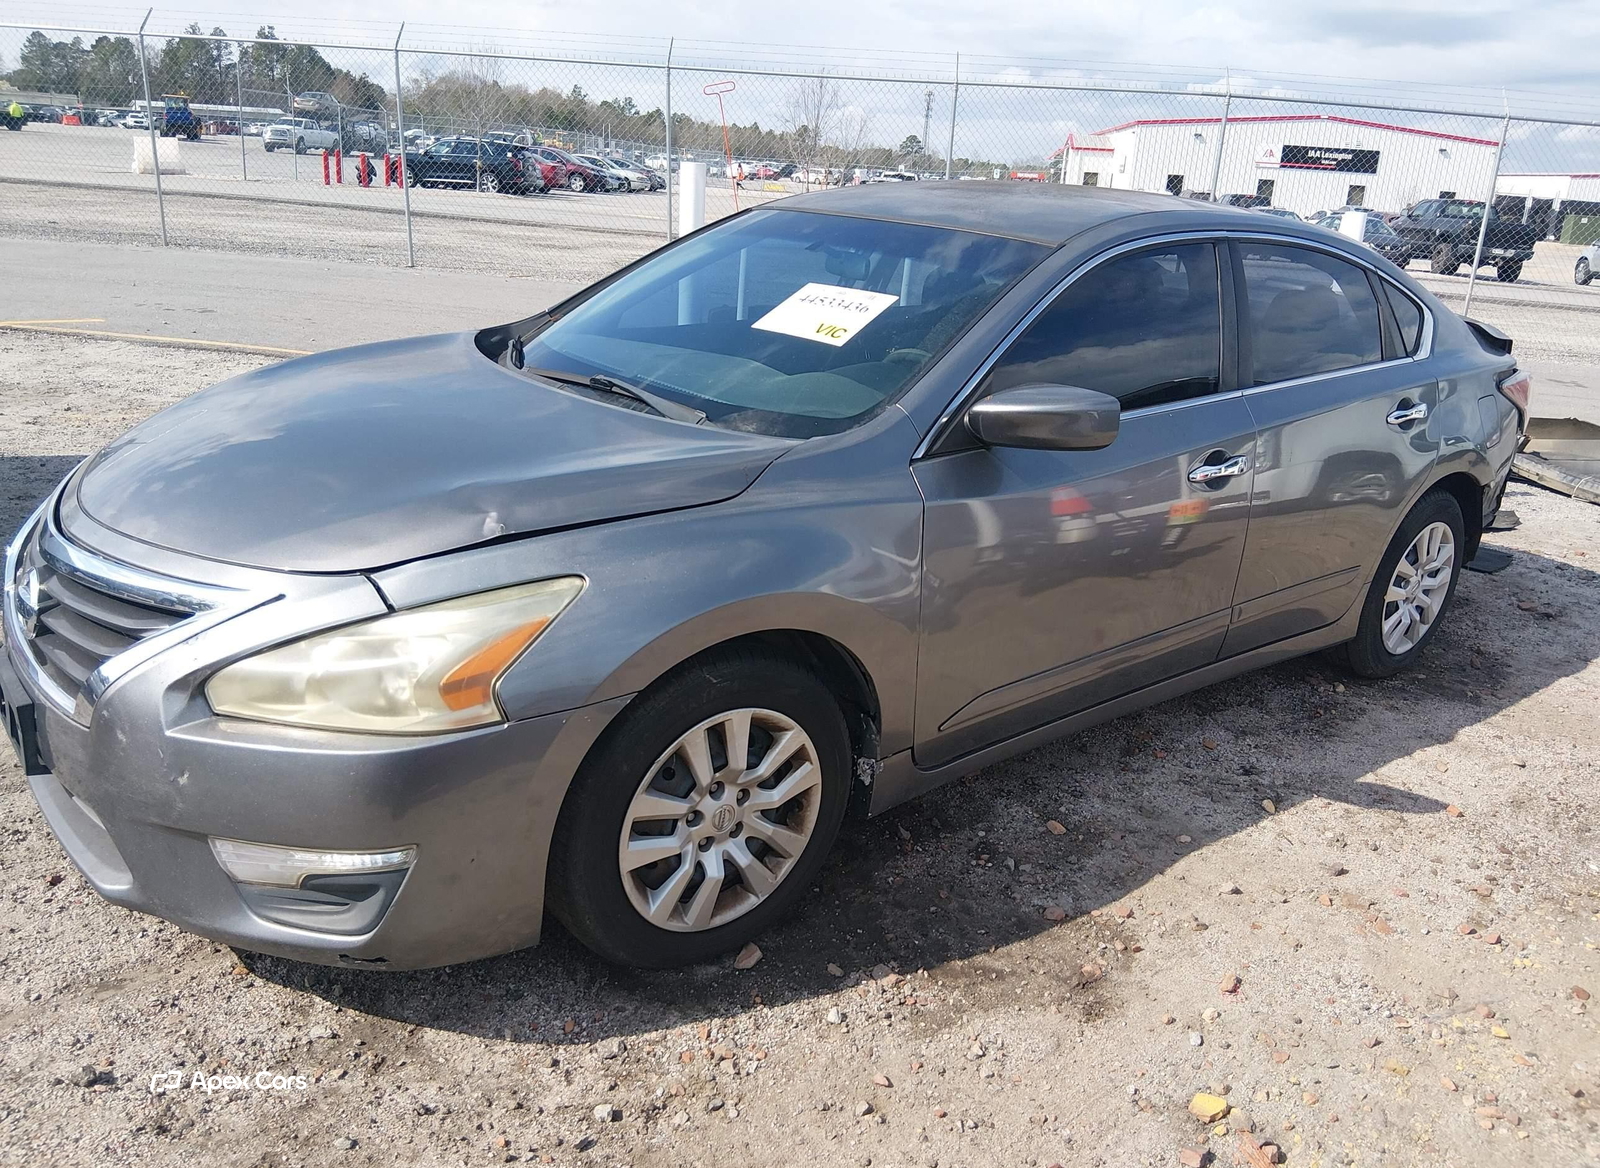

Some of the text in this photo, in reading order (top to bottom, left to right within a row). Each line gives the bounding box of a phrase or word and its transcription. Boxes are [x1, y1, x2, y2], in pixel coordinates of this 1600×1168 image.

[1307, 149, 1352, 160] IAA Lexington
[815, 322, 848, 339] VIC
